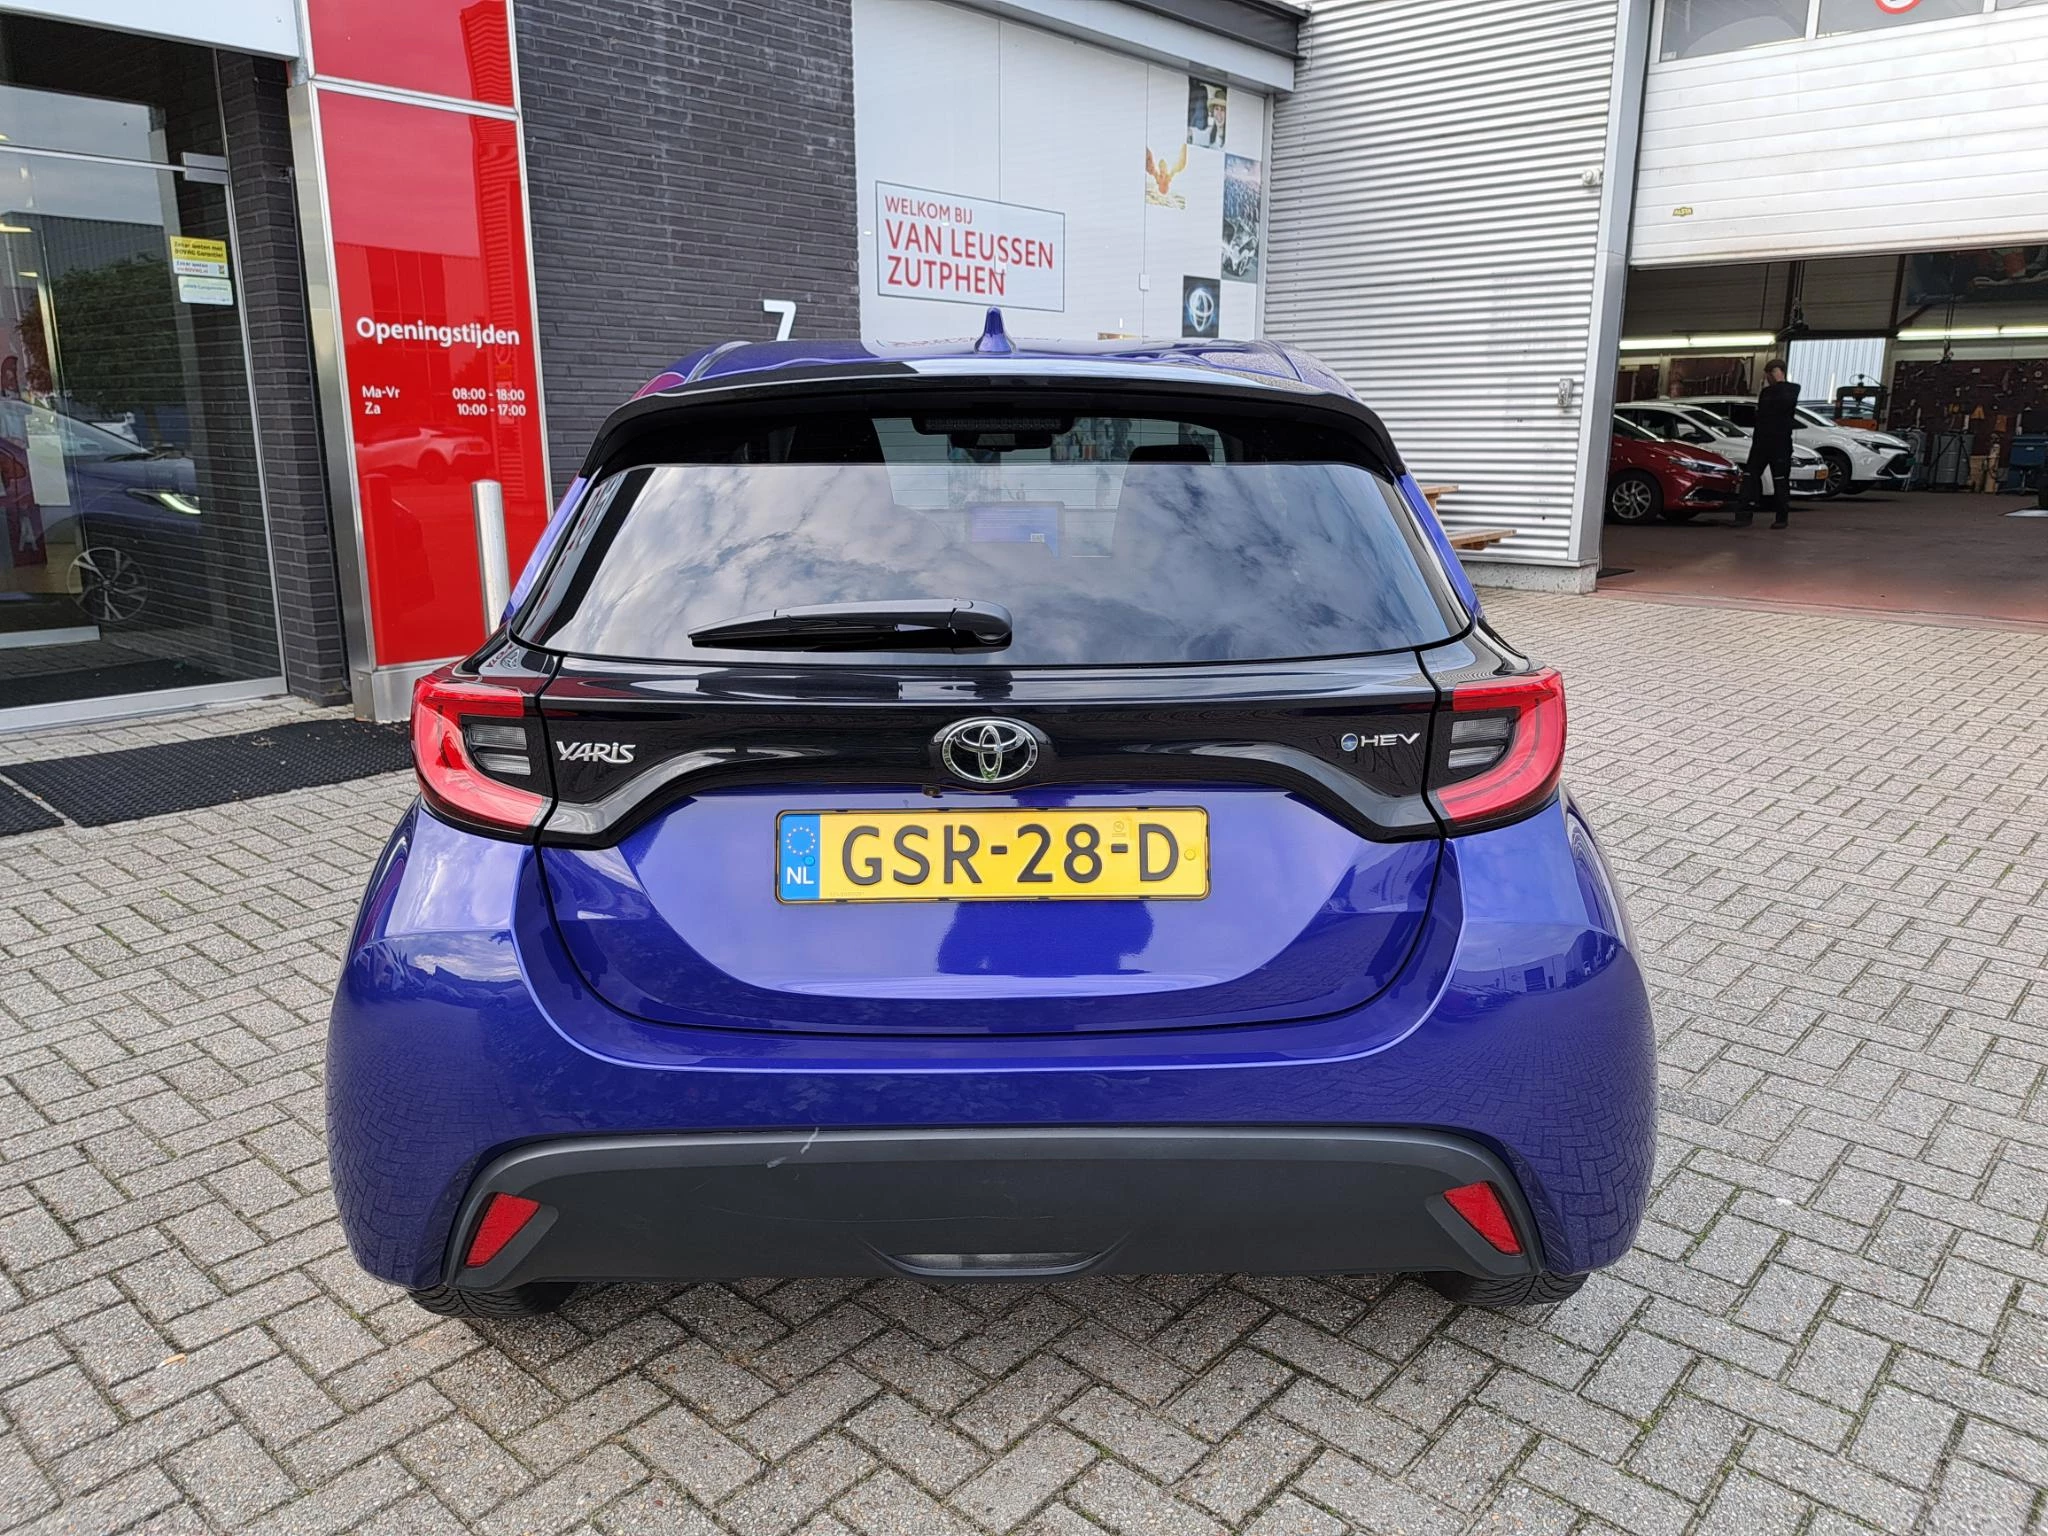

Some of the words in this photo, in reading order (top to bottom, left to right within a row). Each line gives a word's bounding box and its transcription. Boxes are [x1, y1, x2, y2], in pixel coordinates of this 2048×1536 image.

[884, 195, 950, 221] WELKOM
[954, 206, 973, 225] BIJ
[885, 218, 942, 255] VAN
[951, 228, 1053, 270] LEUSSEN
[887, 255, 1006, 296] ZUTPHEN
[356, 317, 520, 348] Openingstijden
[763, 299, 797, 341] 7
[362, 385, 400, 399] Ma-Vr
[452, 387, 486, 400] 08:00
[496, 388, 525, 401] 18:00
[365, 402, 381, 415] Za
[457, 403, 488, 416] 10:00
[498, 404, 527, 416] 17:00
[1360, 732, 1421, 748] HEV
[842, 823, 1179, 886] GSR-28-D
[786, 866, 815, 885] NL
